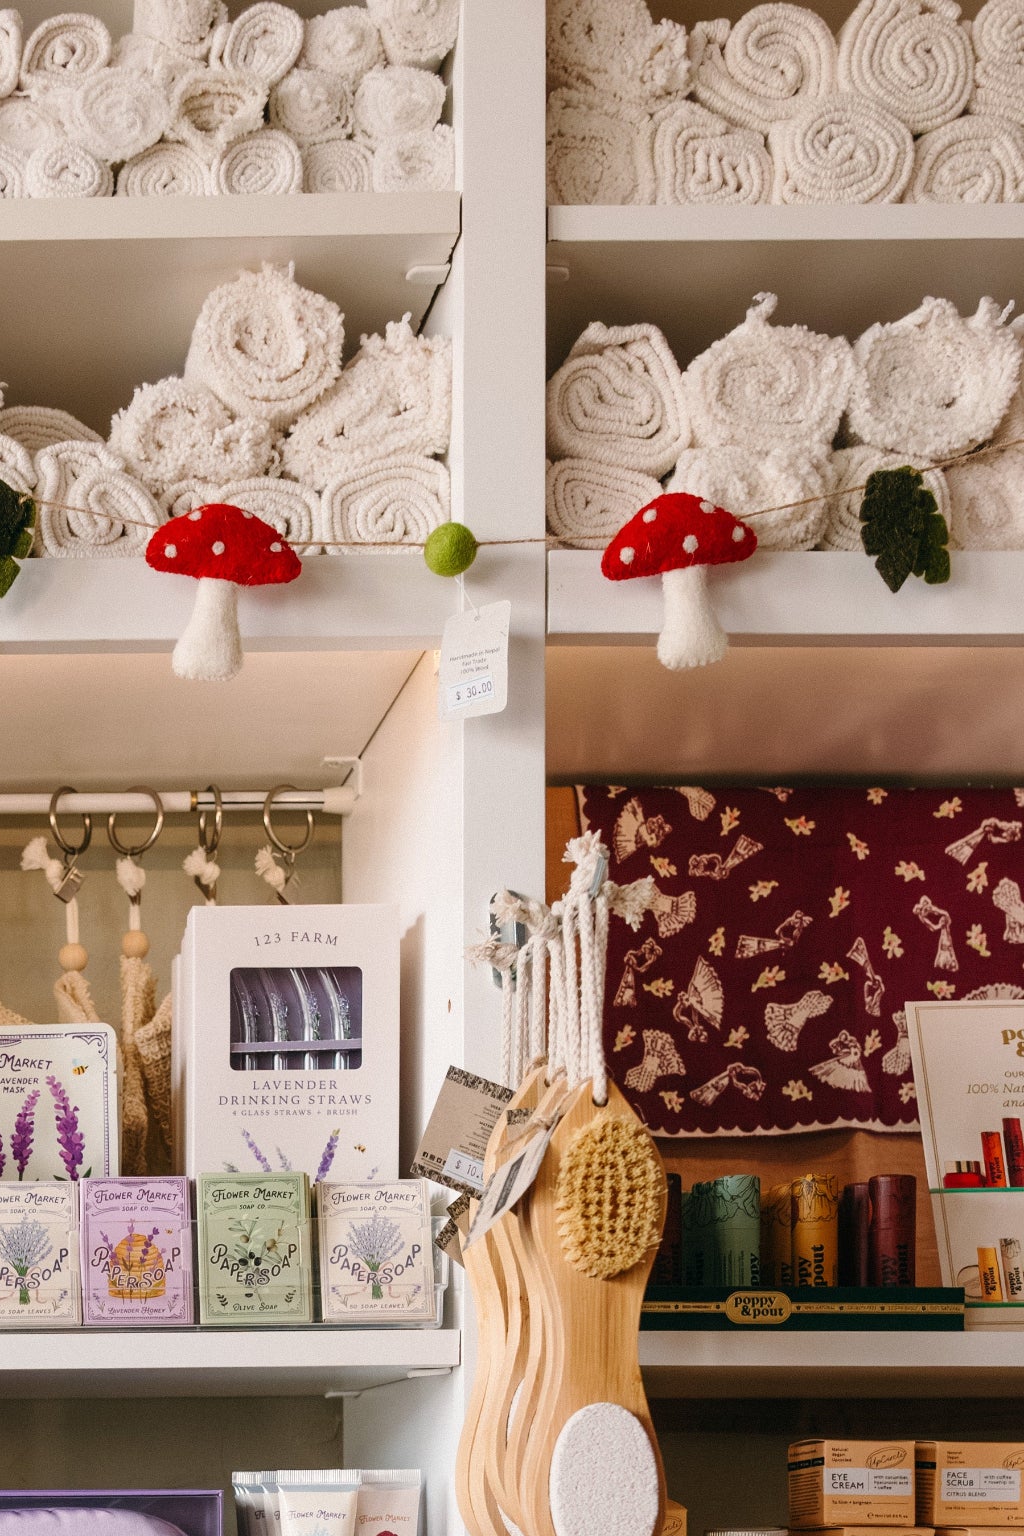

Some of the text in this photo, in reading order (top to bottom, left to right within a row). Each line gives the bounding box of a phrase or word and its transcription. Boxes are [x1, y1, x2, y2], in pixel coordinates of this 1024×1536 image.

[450, 651, 477, 662] Handmade
[456, 681, 492, 700] $ 30.00
[254, 931, 338, 946] 123 FARM
[253, 1080, 338, 1090] LAVENDER
[218, 1094, 372, 1106] DRINKING STRAWS
[94, 1189, 178, 1203] FLOWER MARKET
[212, 1188, 294, 1202] FLOWER MARKET
[91, 1247, 180, 1288] PAPER SOAP
[211, 1244, 297, 1286] PAPER SOAP
[233, 1302, 278, 1311] OLIVE SOAP
[734, 1295, 776, 1308] poppy
[108, 1306, 166, 1315] LAVENDER HONEY
[288, 1509, 347, 1520] FLOWER MARKET
